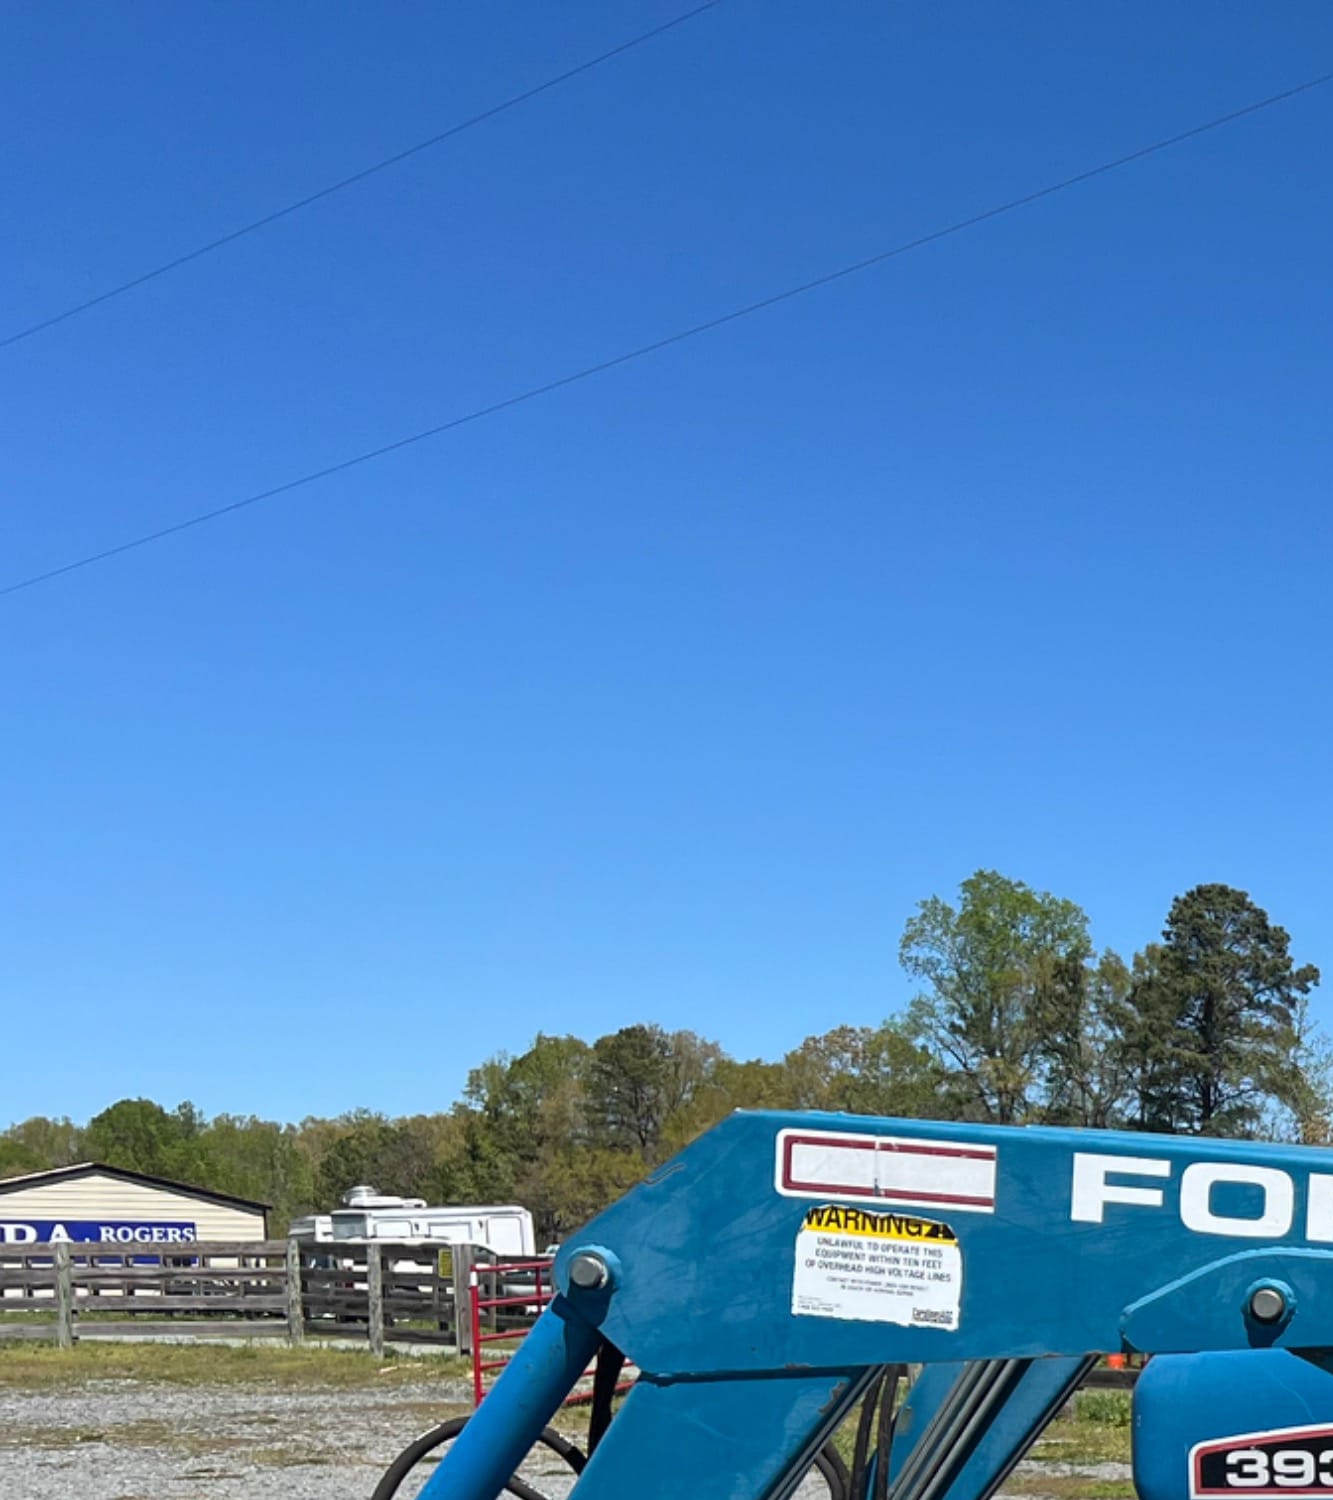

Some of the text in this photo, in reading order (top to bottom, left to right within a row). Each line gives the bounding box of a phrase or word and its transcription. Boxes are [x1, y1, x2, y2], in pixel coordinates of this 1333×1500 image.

[804, 1205, 922, 1238] WARNING
[99, 1225, 194, 1243] ROGERS
[816, 1237, 944, 1258] UNLAWFUL TO OPERATE THIS
[815, 1248, 943, 1270] EQUIPMENT WITHIN TEN FEET
[805, 1259, 952, 1283] OF OVERHEAD HIGH VOLTAGE LINES
